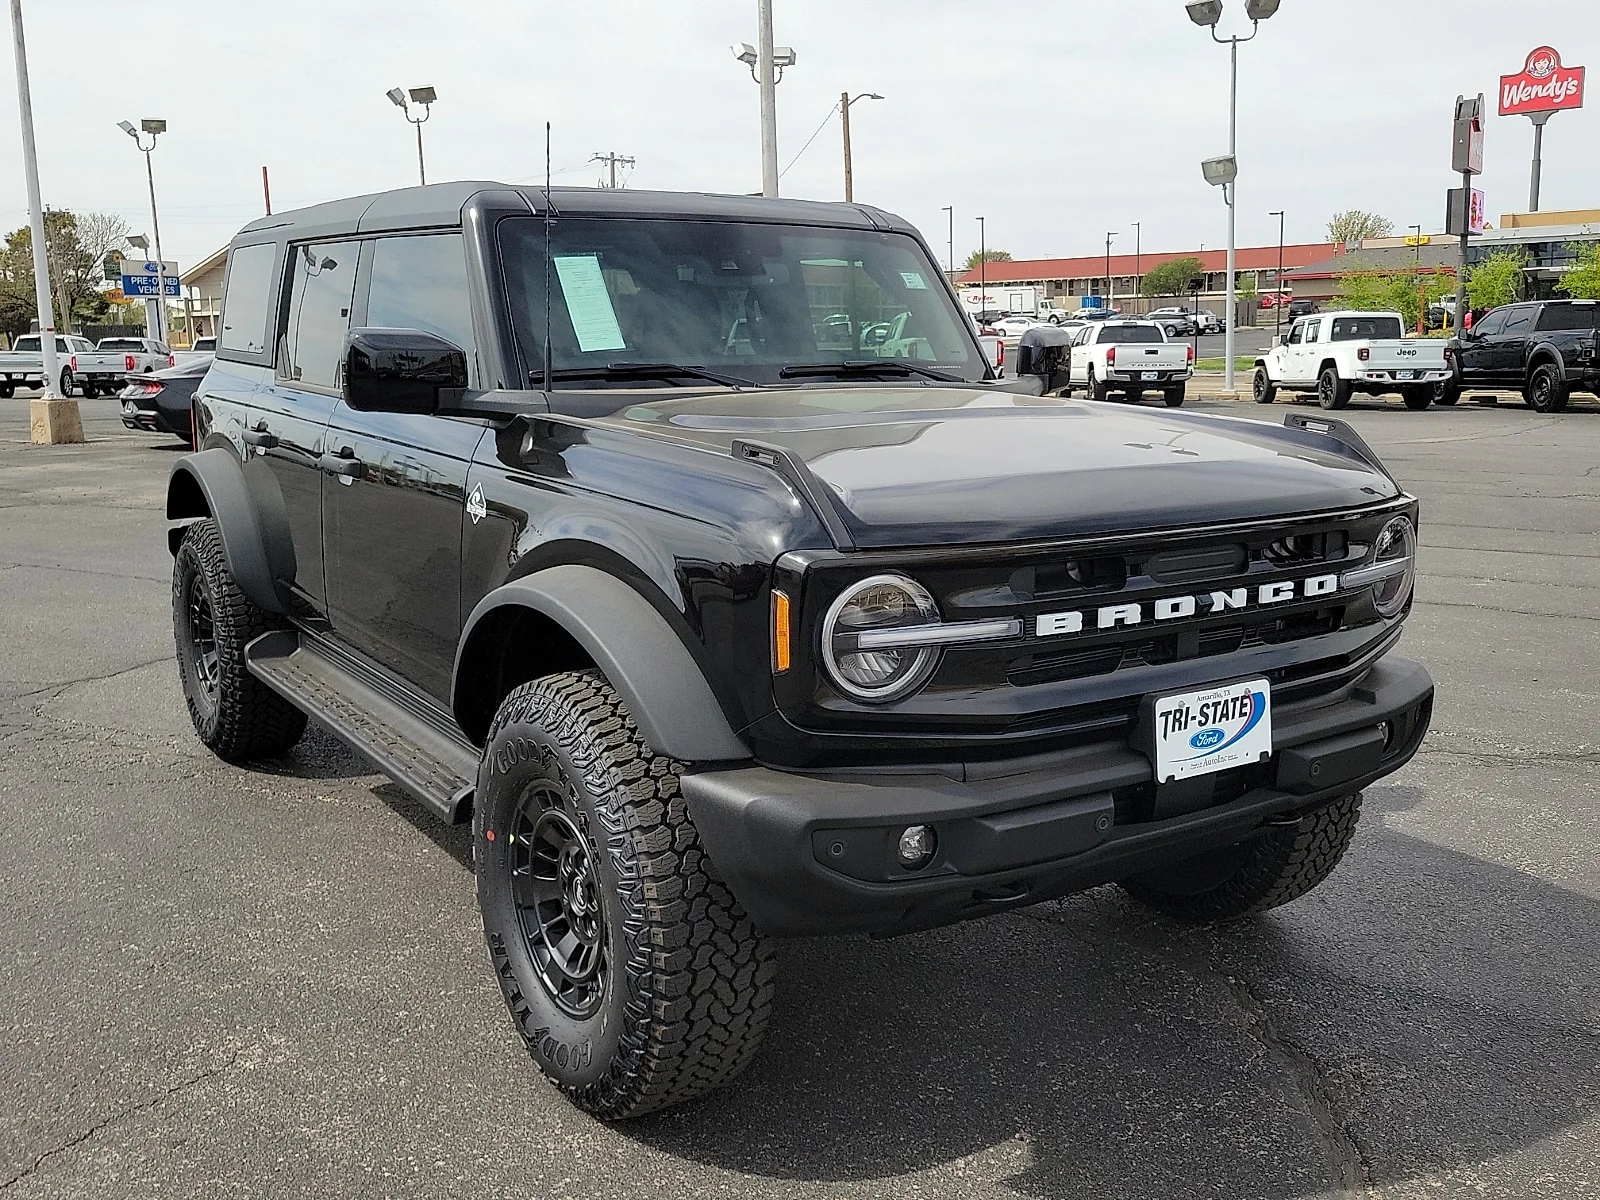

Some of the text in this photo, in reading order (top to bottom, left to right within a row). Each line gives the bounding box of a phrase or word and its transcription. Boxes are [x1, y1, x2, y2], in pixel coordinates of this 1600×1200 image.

[1503, 74, 1579, 108] Wendy's
[131, 276, 178, 285] PRE-ONED
[138, 286, 175, 295] VEHICES
[1396, 348, 1417, 356] Jeep
[1036, 574, 1338, 637] BRONCO
[1159, 694, 1249, 741] TRI-STATE
[1196, 732, 1219, 747] Ford
